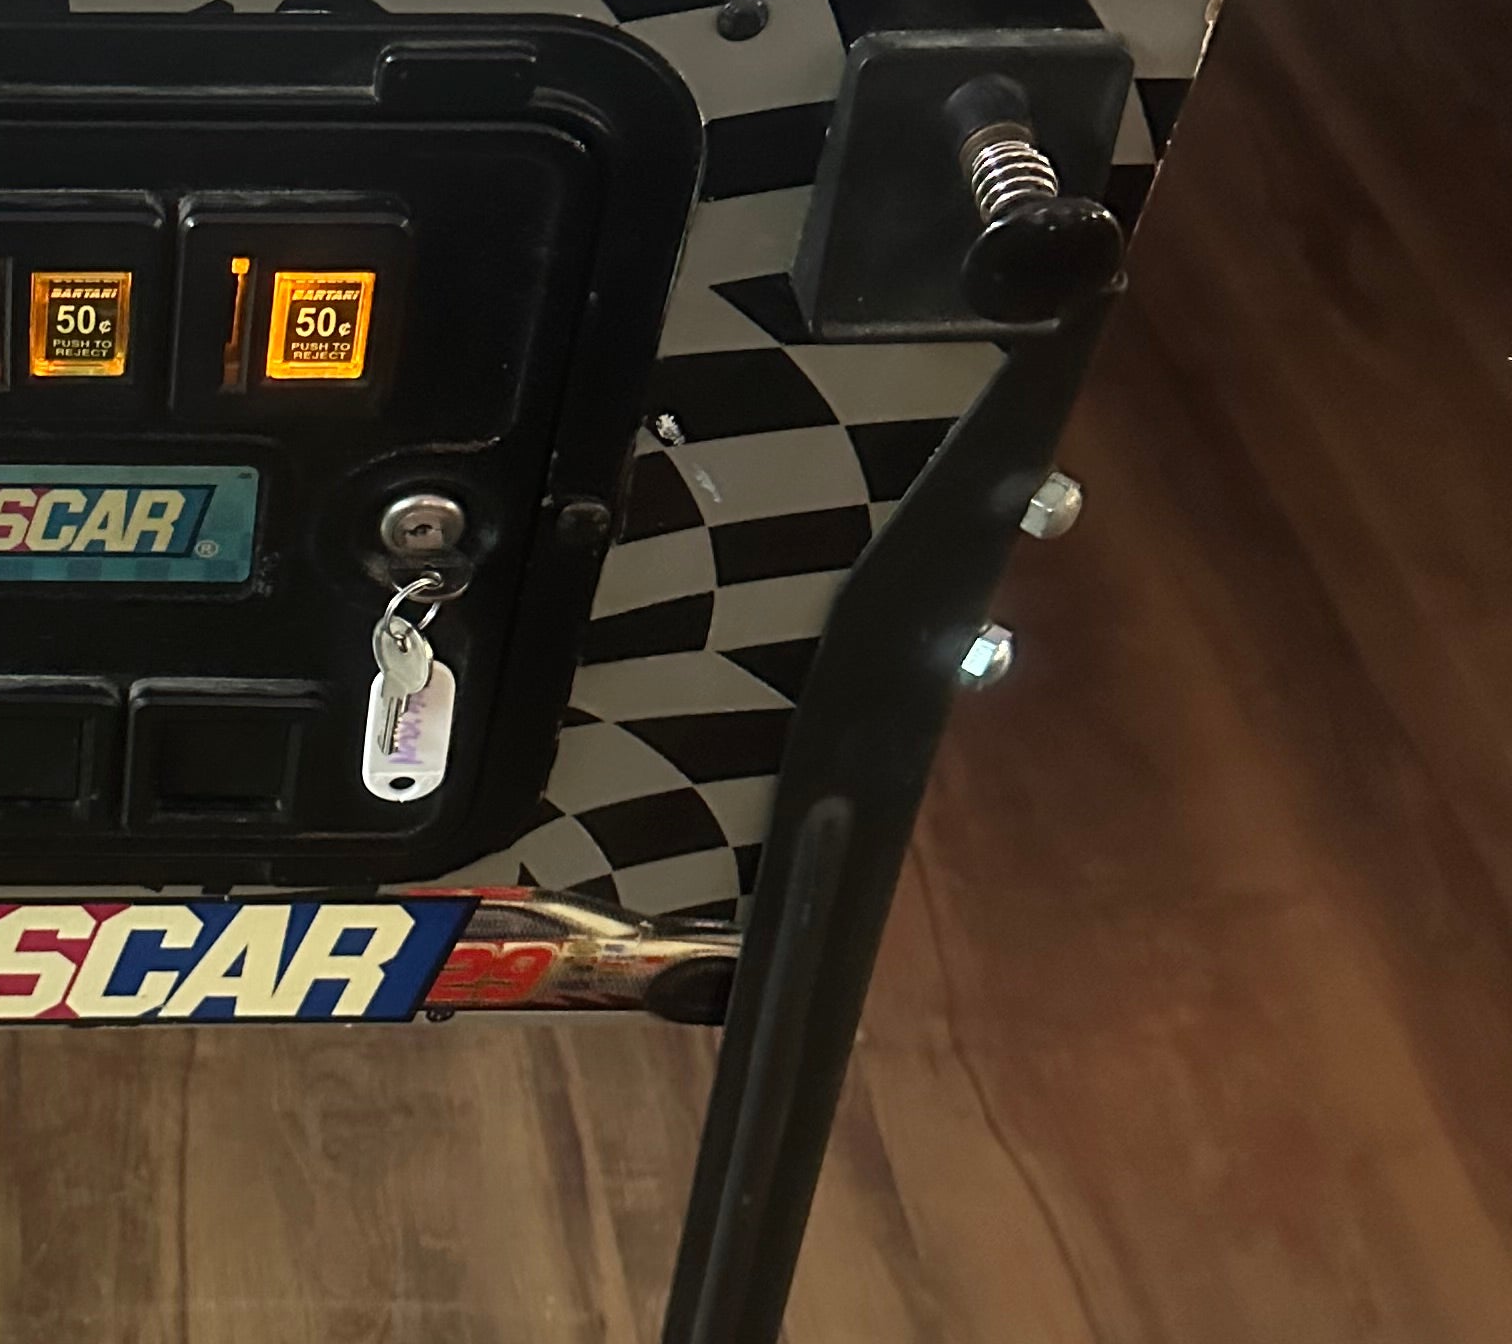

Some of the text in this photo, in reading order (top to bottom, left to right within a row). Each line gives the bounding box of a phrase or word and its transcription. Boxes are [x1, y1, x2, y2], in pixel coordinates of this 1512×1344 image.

[53, 339, 112, 348] PUSH TO
[291, 342, 351, 351] PUSH TO
[55, 349, 109, 357] REJECT
[293, 351, 346, 360] REJECT
